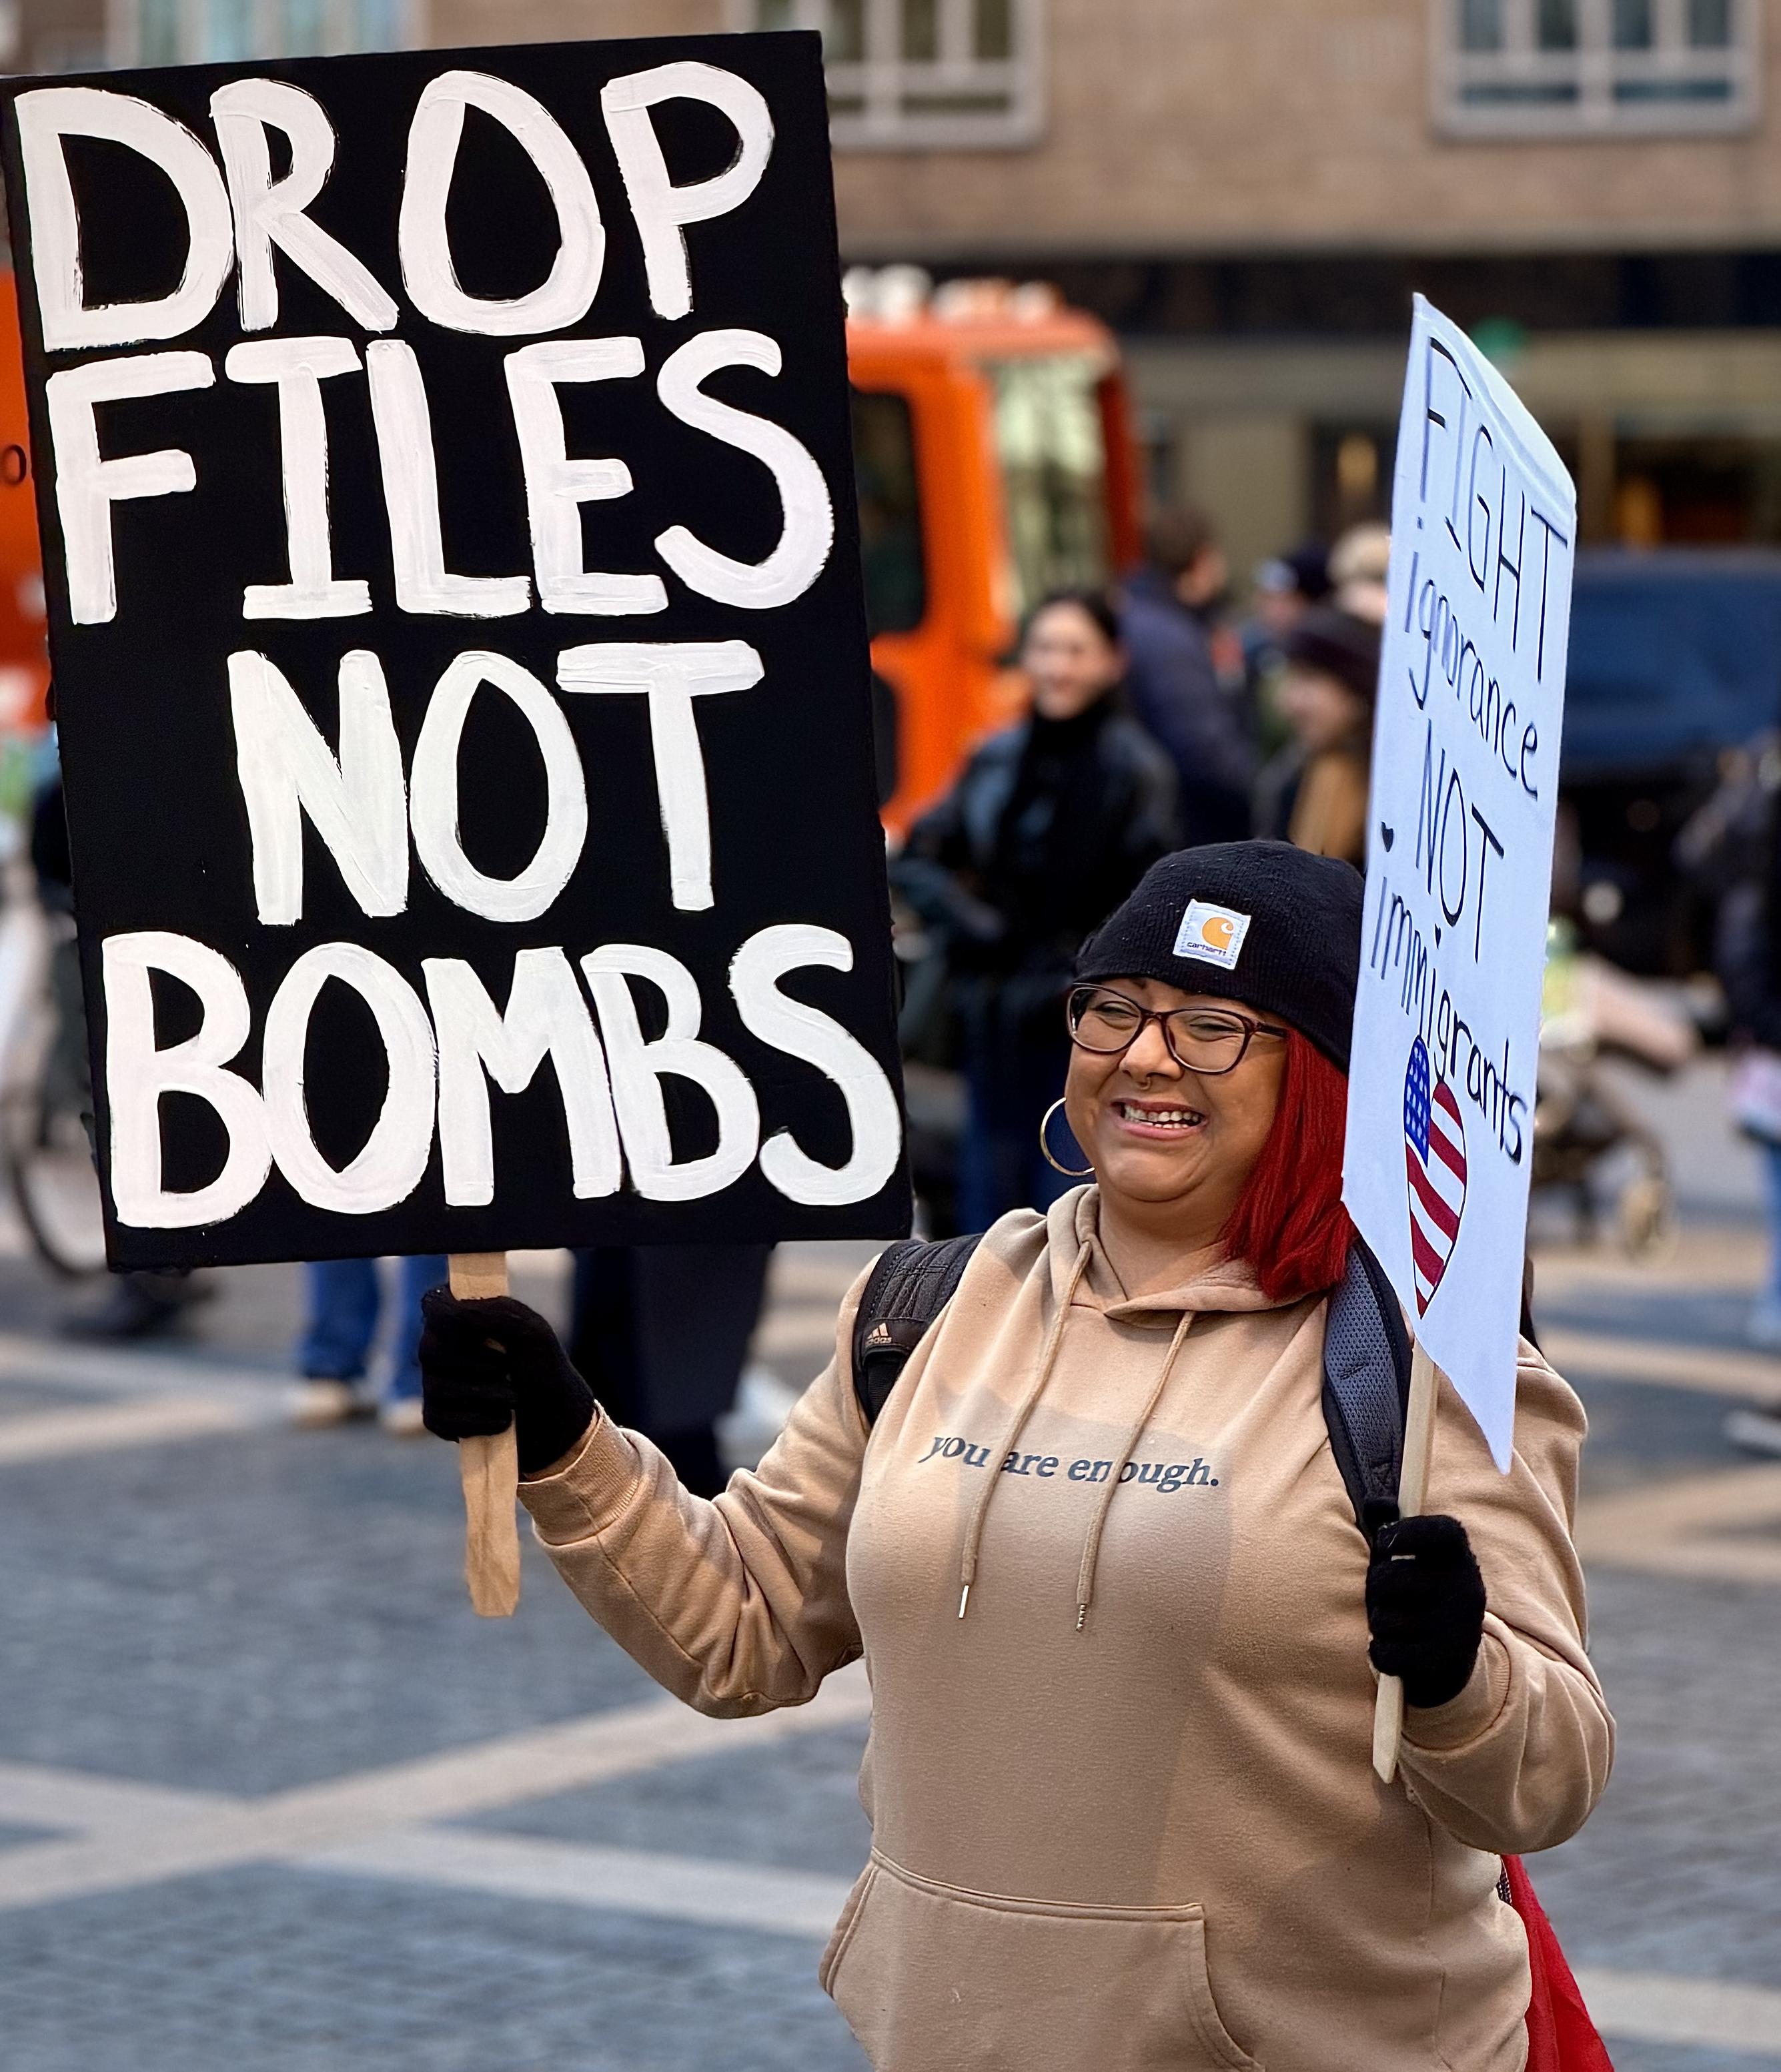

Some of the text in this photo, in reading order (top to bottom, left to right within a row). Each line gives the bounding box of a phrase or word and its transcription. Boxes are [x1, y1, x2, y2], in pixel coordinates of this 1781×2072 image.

[13, 61, 774, 354] DROP
[46, 329, 834, 626] FILES
[1421, 336, 1568, 684] FIGHT
[227, 639, 765, 926] NOT
[1403, 516, 1539, 802] ignorance
[1187, 941, 1227, 957] carhartt
[1415, 718, 1505, 964] NOT
[102, 923, 901, 1229] BOMBS
[917, 1436, 1220, 1494] you are enough.
